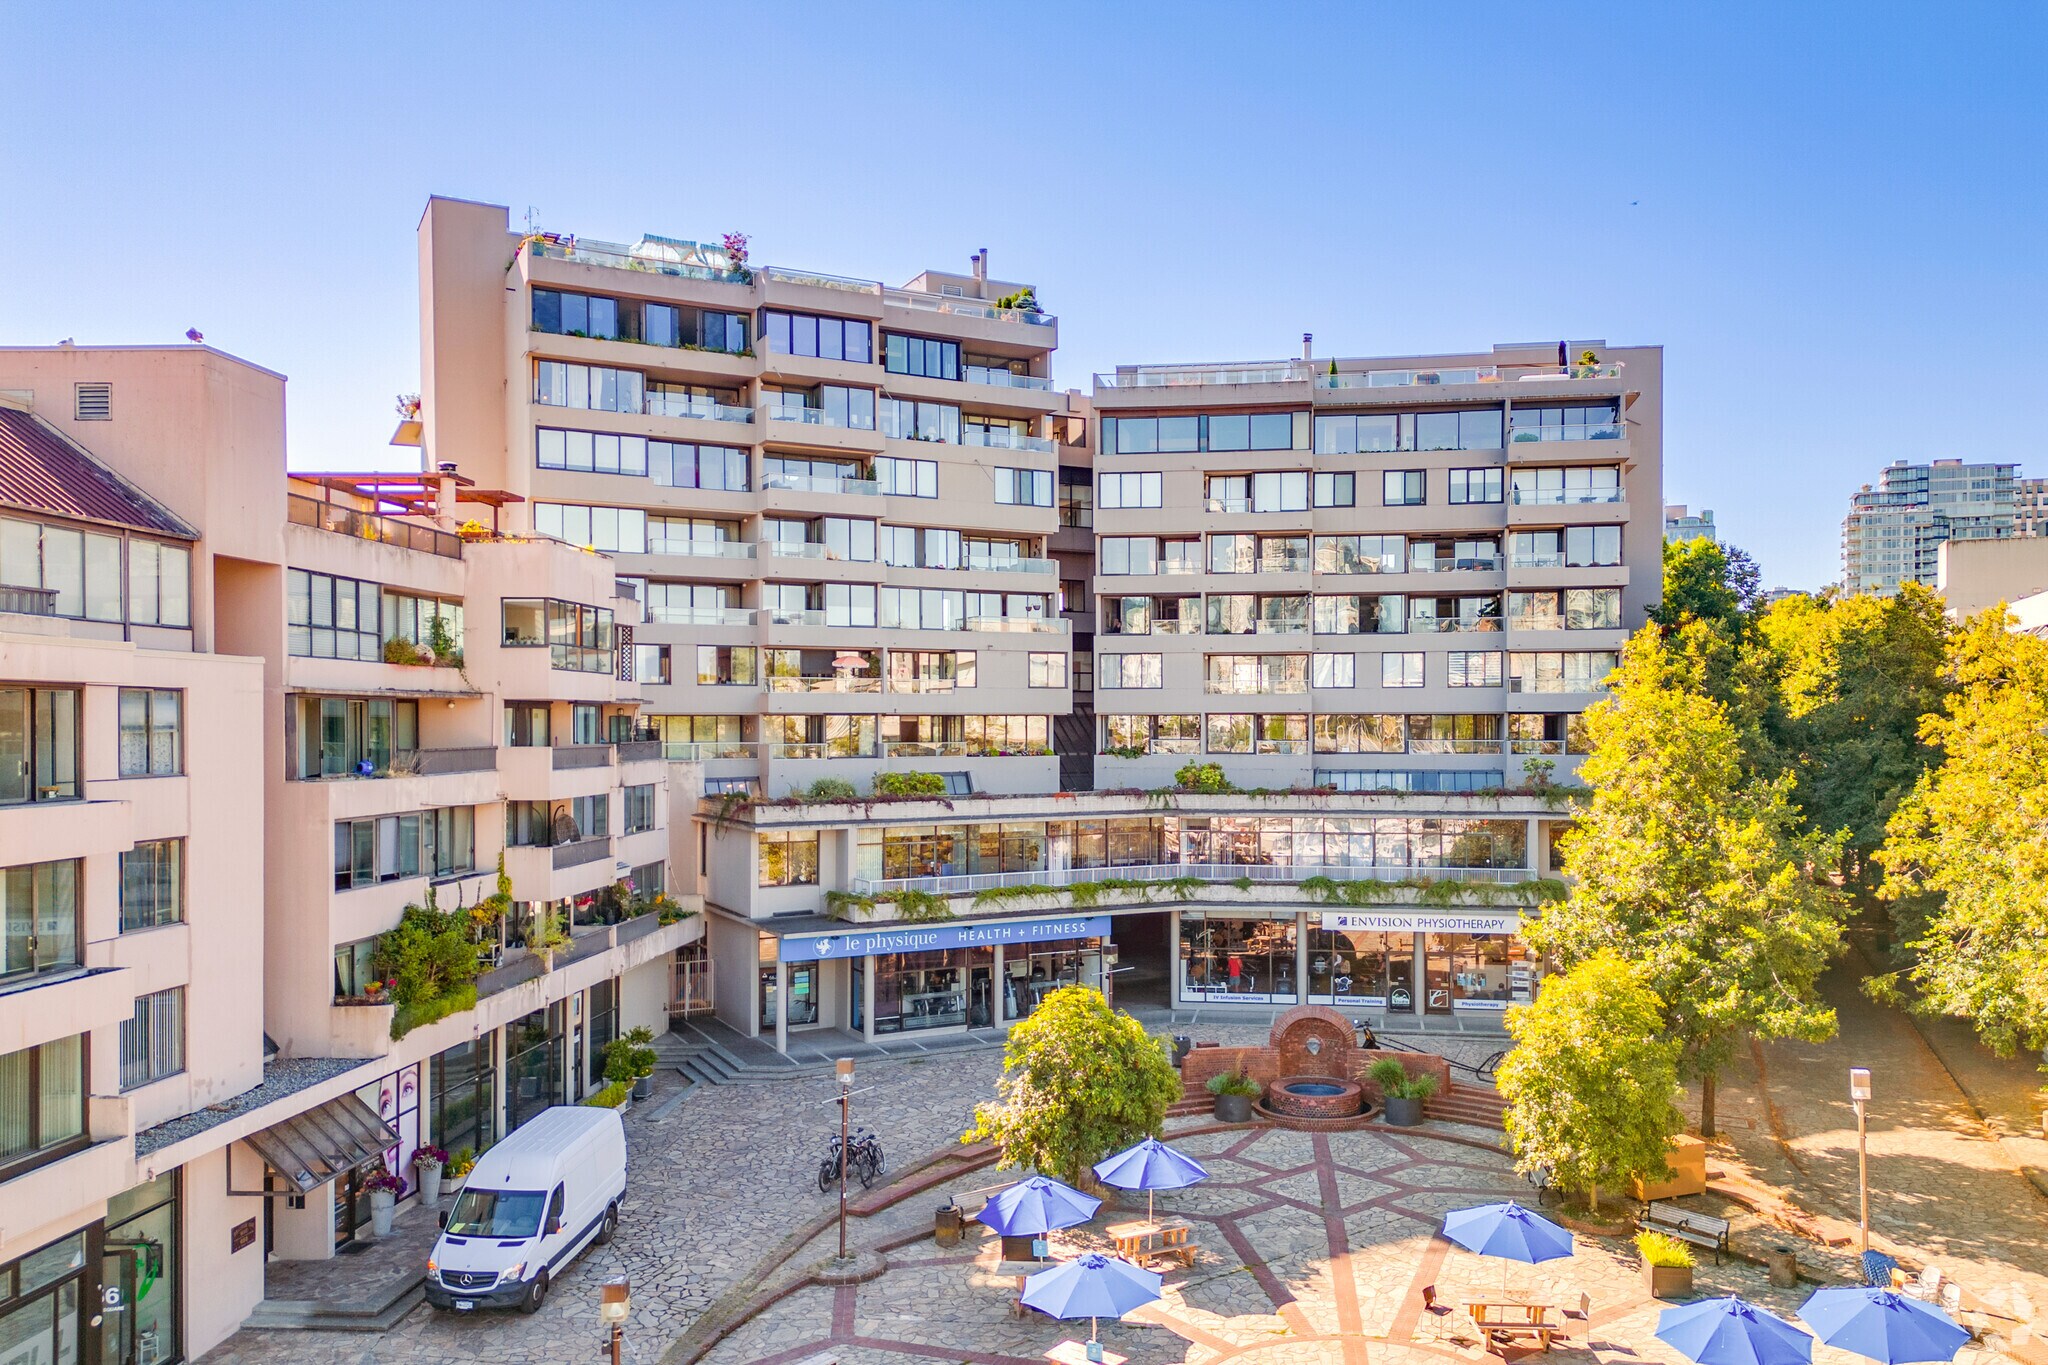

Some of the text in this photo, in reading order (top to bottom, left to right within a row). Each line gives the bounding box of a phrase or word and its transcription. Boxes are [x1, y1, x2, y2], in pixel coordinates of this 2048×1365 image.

[1351, 916, 1505, 930] ENVISION PHYSIOTHERAPY
[844, 935, 860, 951] le
[866, 931, 938, 953] physique
[958, 927, 1011, 942] HEALTH
[1032, 922, 1086, 936] FITNESS
[102, 1287, 120, 1304] 6
